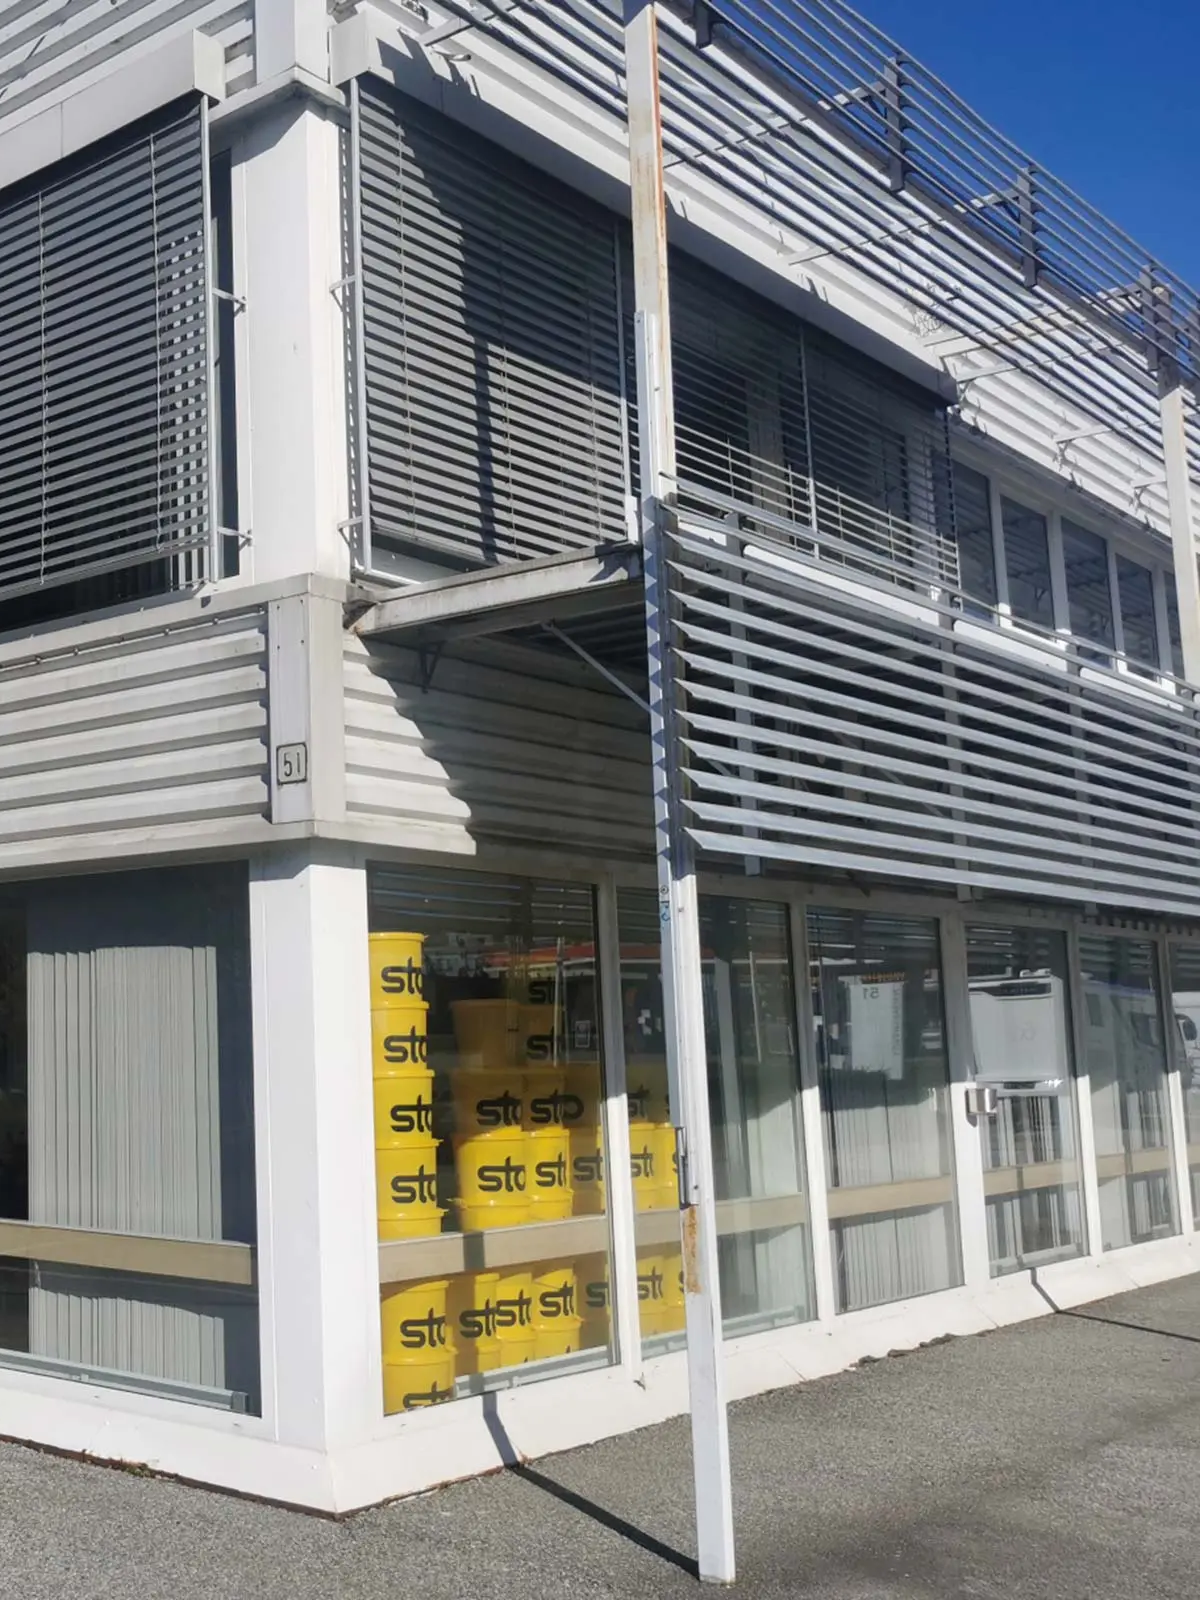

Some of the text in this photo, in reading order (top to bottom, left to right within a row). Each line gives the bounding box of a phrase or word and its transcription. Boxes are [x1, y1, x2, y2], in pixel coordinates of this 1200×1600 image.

[282, 750, 302, 777] 51
[535, 1151, 567, 1188] st
[460, 1298, 496, 1338] st
[496, 1289, 532, 1327] st
[540, 1280, 574, 1318] st
